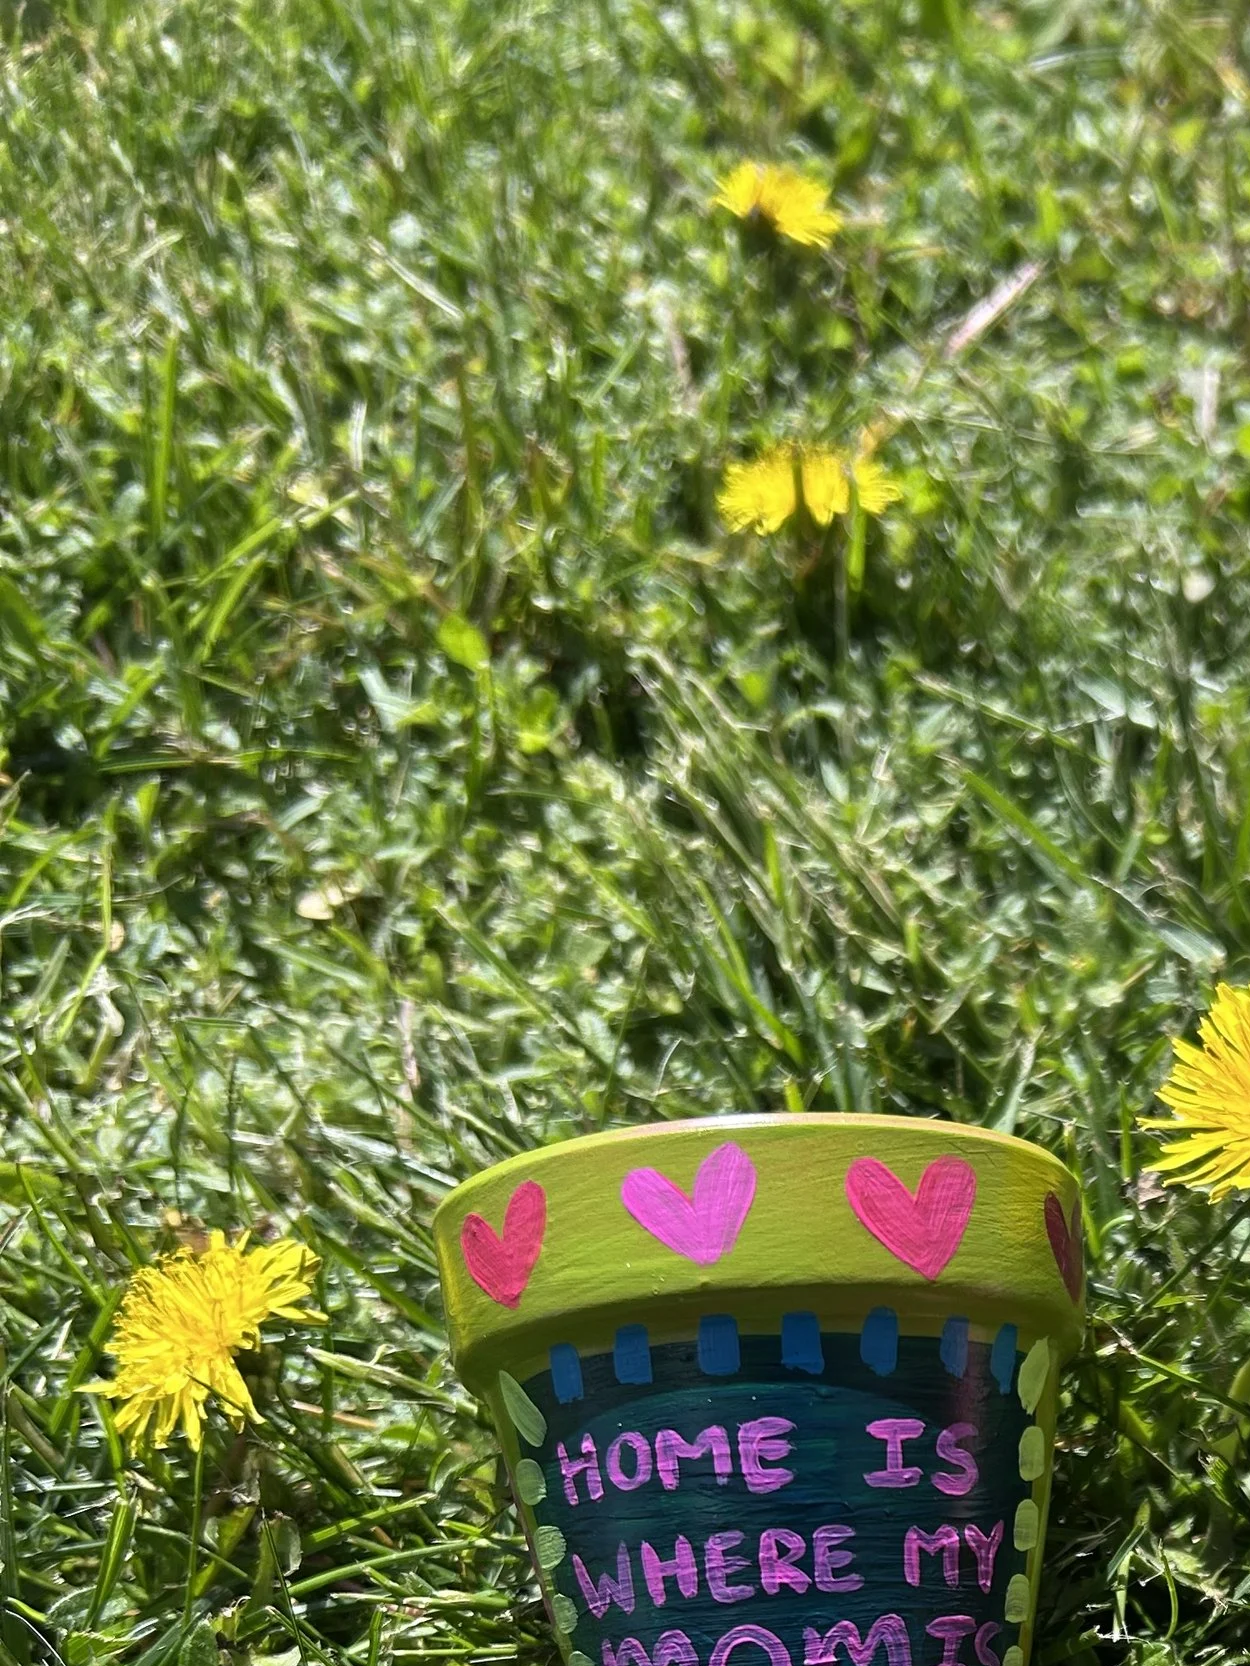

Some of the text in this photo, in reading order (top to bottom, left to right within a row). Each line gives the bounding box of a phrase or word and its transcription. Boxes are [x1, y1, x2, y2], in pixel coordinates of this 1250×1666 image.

[556, 1416, 980, 1506] HOME IS
[571, 1519, 1005, 1619] WHERE MY
